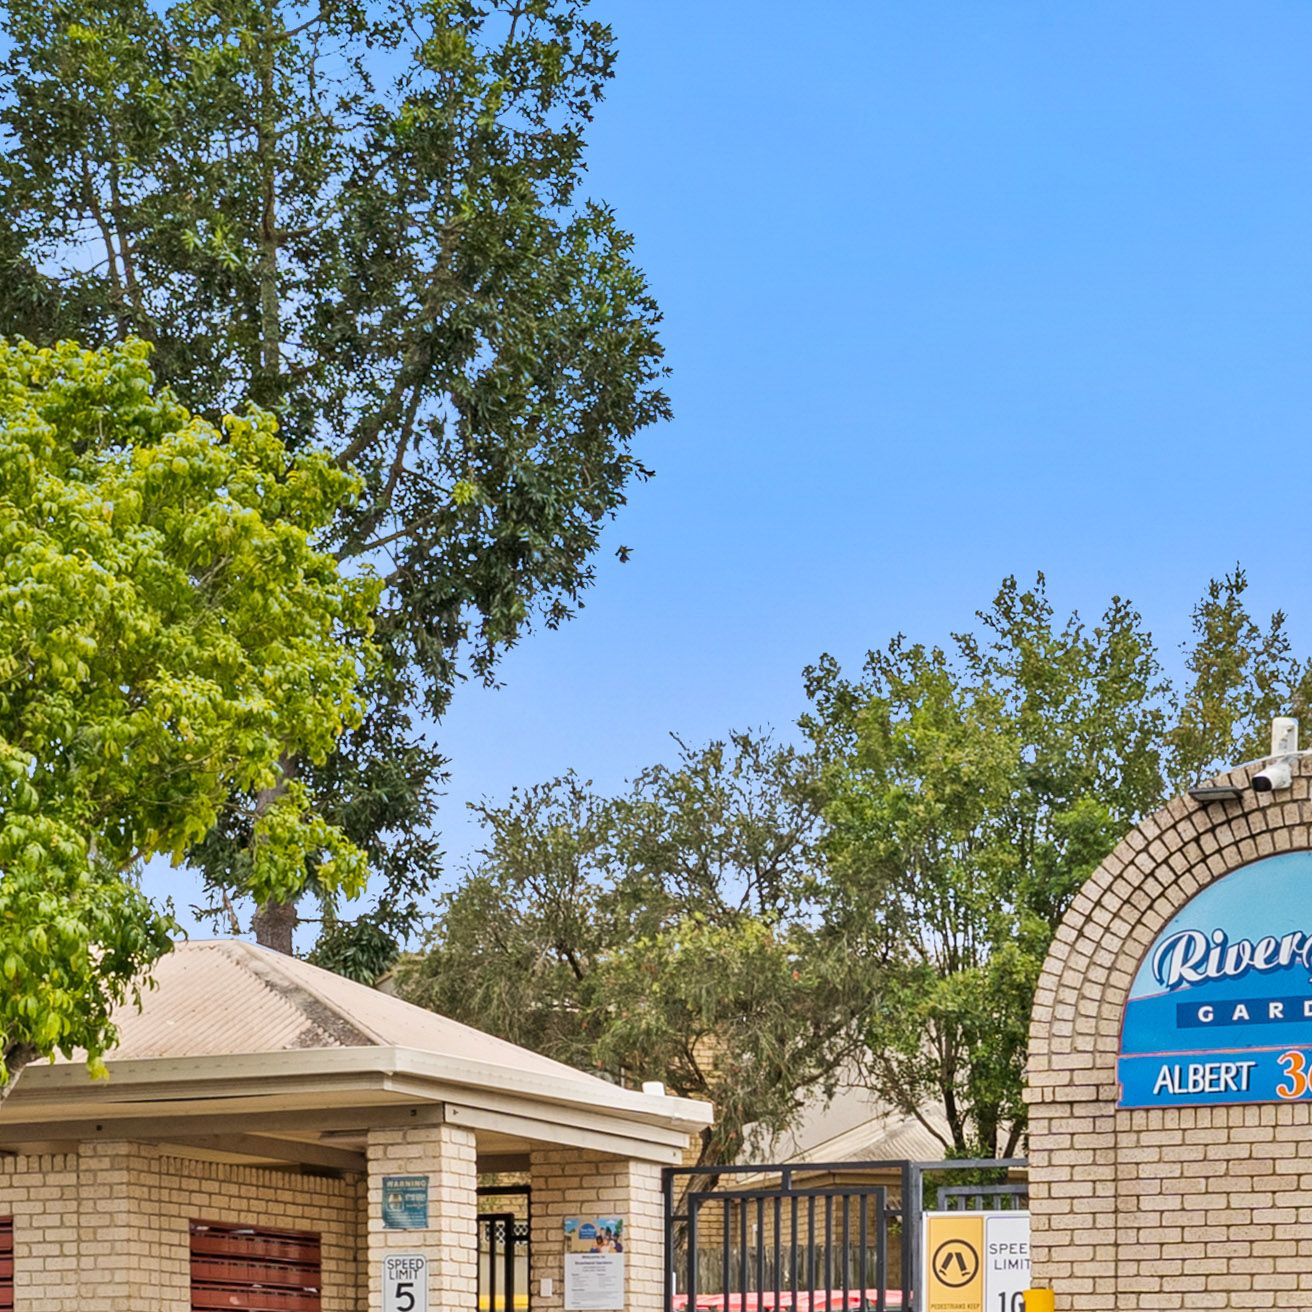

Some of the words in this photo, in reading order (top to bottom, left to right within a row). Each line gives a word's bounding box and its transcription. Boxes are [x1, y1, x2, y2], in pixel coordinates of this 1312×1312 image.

[1153, 1060, 1257, 1095] ALBERT
[989, 1243, 1029, 1255] SPEE
[387, 1258, 424, 1270] SPEED
[994, 1258, 1030, 1270] LIMIT
[389, 1269, 419, 1280] LIMIT
[395, 1282, 415, 1312] 5
